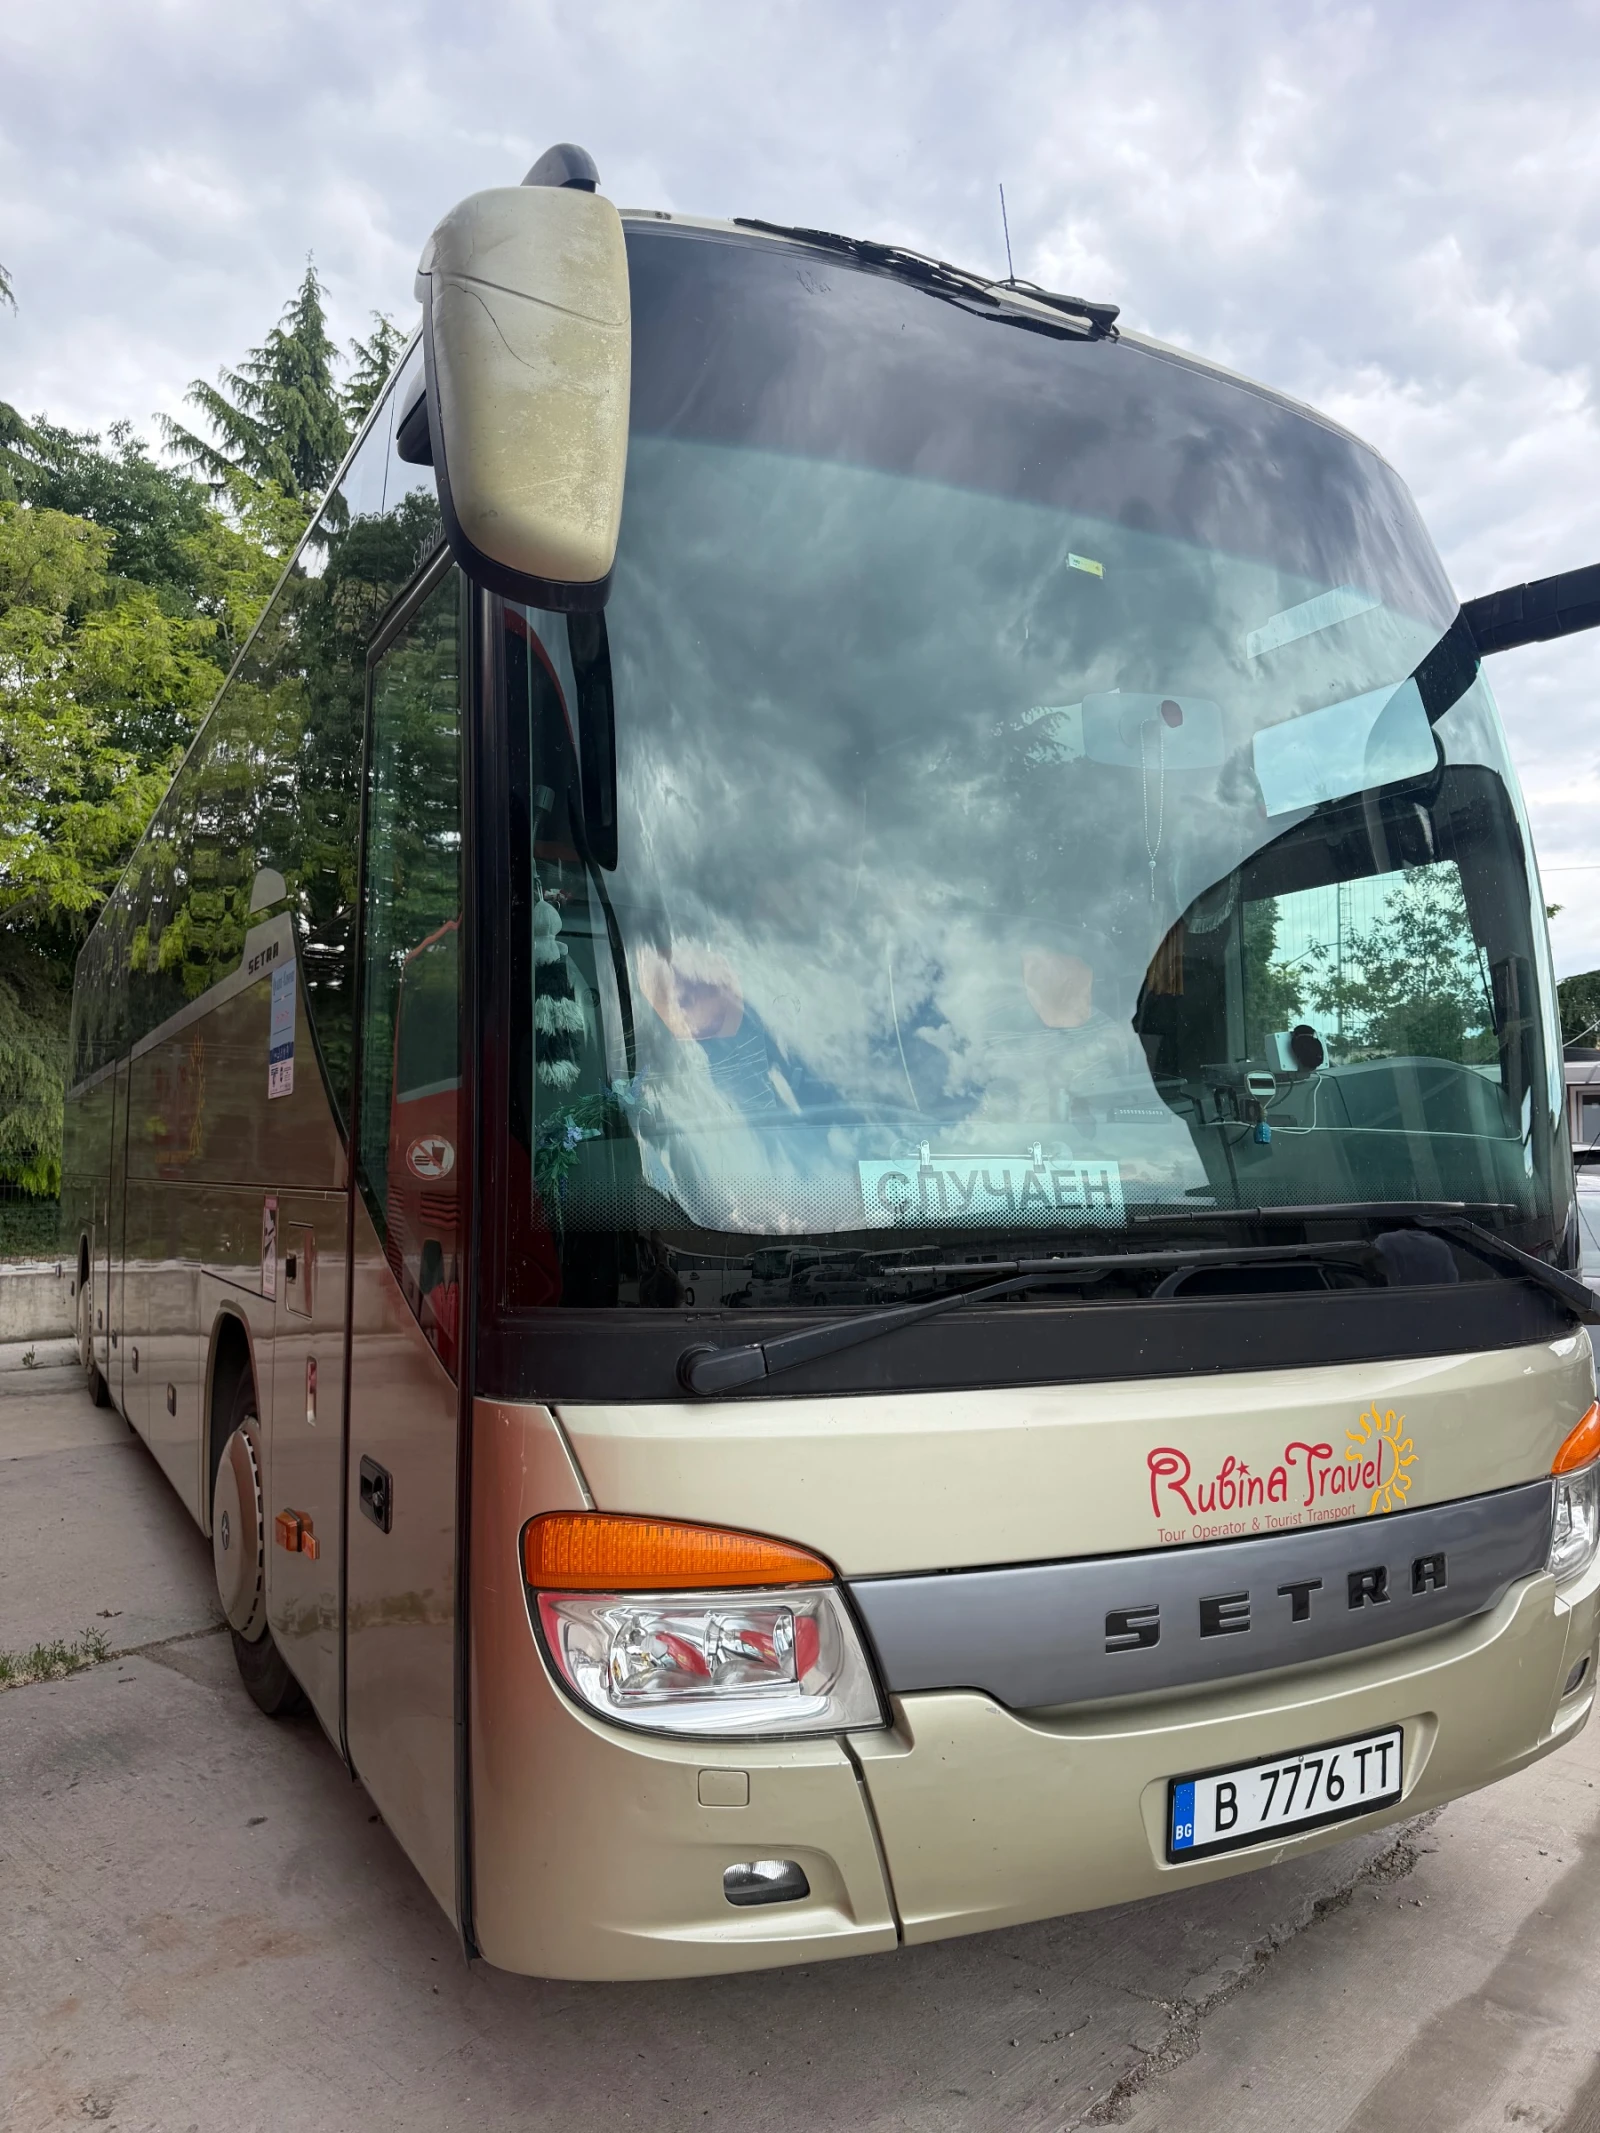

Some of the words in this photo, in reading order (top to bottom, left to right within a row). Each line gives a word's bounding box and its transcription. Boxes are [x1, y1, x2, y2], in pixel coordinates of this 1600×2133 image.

[248, 941, 279, 975] SETRA
[877, 1168, 1114, 1215] СЛУЧАЕН
[1284, 1438, 1382, 1507] Travel
[1157, 1527, 1187, 1543] Tour
[1192, 1521, 1246, 1541] Operator
[1251, 1517, 1261, 1532] &
[1264, 1512, 1303, 1529] Tourist
[1306, 1503, 1357, 1521] Transport
[1105, 1551, 1448, 1655] SETRA
[1214, 1780, 1239, 1833] B
[1260, 1754, 1345, 1822] 7776
[1353, 1739, 1394, 1795] TT
[1174, 1823, 1193, 1840] BG
